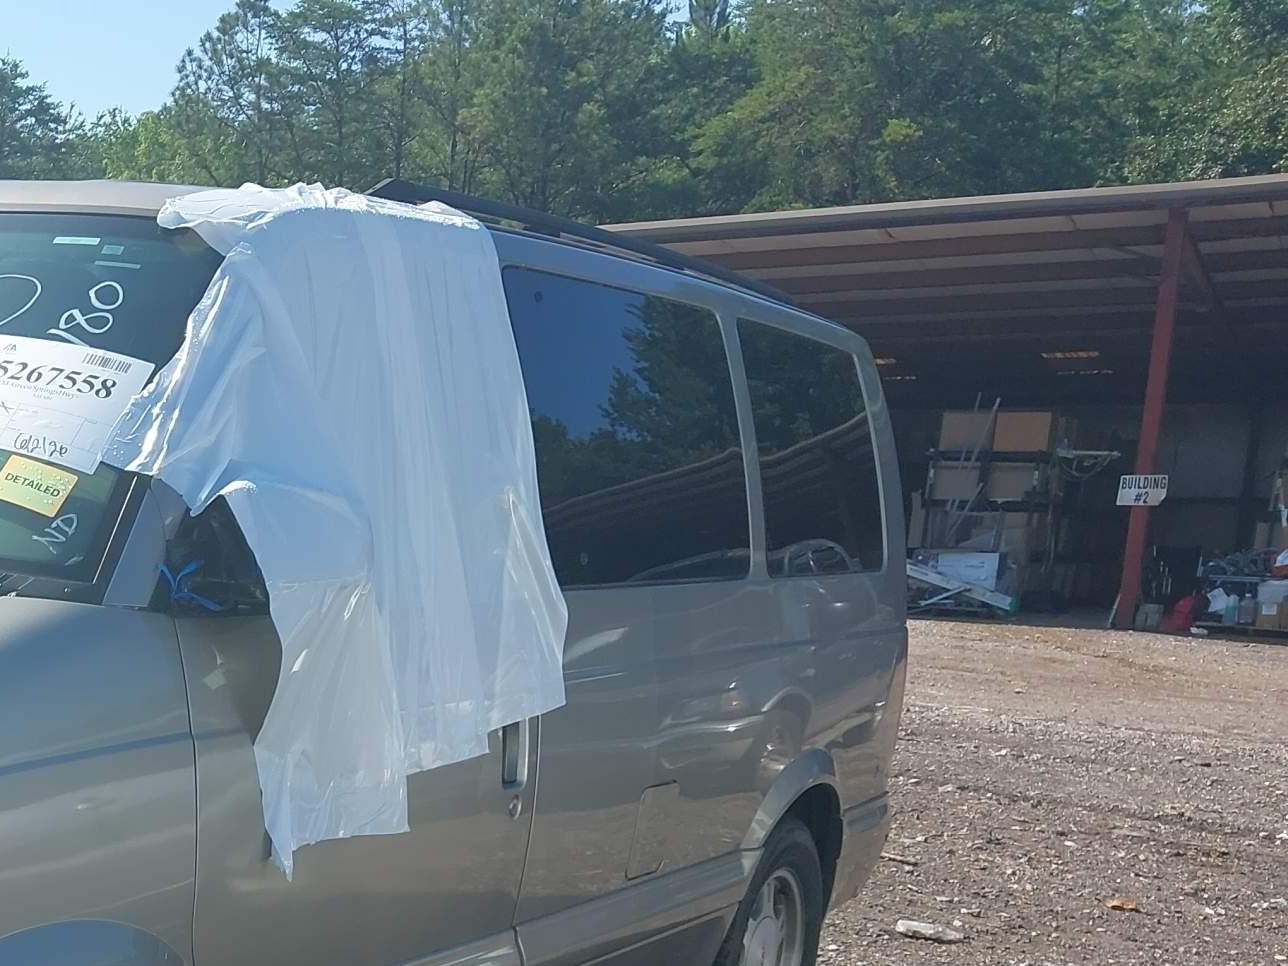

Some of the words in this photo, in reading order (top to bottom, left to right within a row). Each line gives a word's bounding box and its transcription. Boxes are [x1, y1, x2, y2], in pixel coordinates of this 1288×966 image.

[4, 471, 61, 498] DETAILED
[1122, 476, 1167, 490] BUILDING
[1134, 491, 1150, 504] #2
